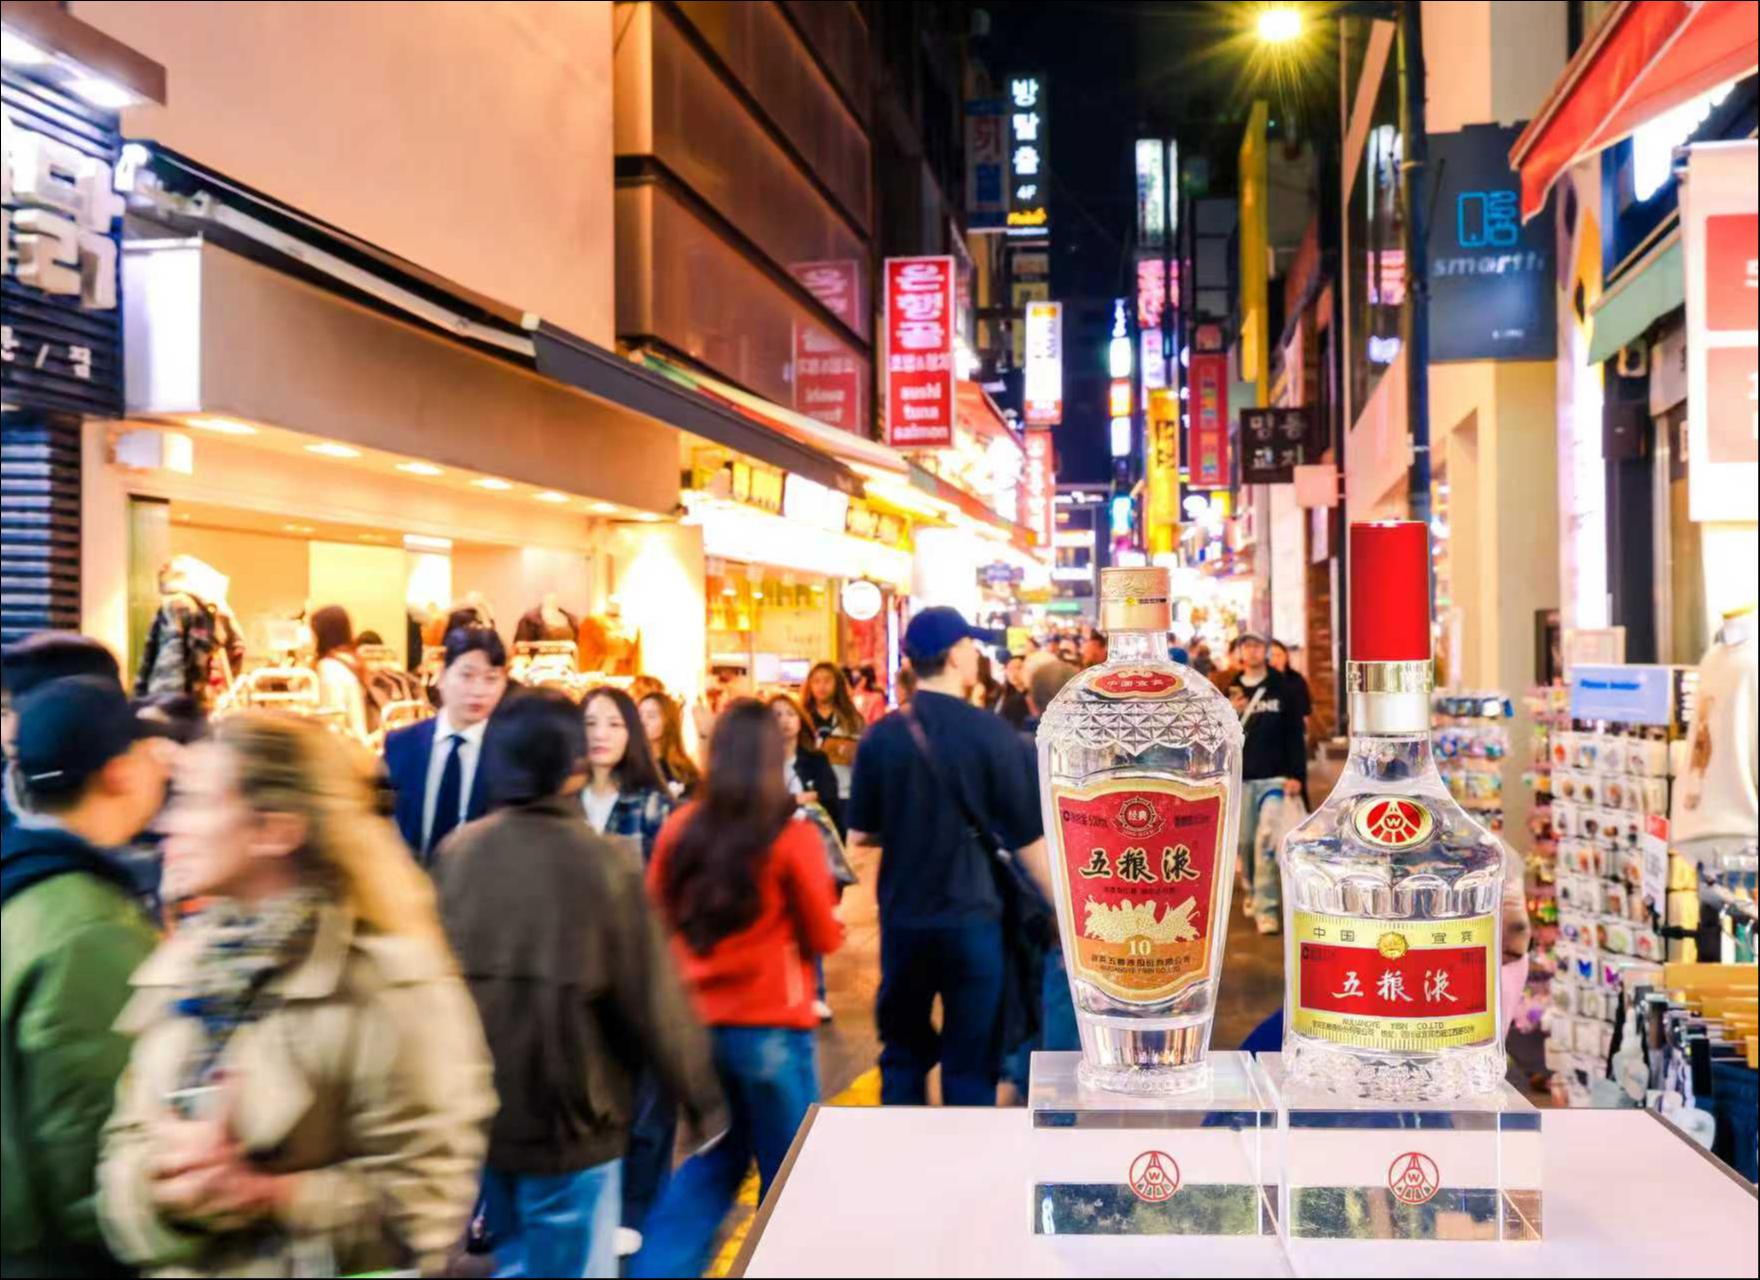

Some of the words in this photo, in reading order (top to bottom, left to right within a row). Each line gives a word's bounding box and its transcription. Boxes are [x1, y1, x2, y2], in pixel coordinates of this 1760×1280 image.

[1079, 843, 1200, 884] 五粮液
[1313, 927, 1355, 943] 中国
[1128, 940, 1152, 956] 10
[1331, 968, 1459, 1003] 五粮液
